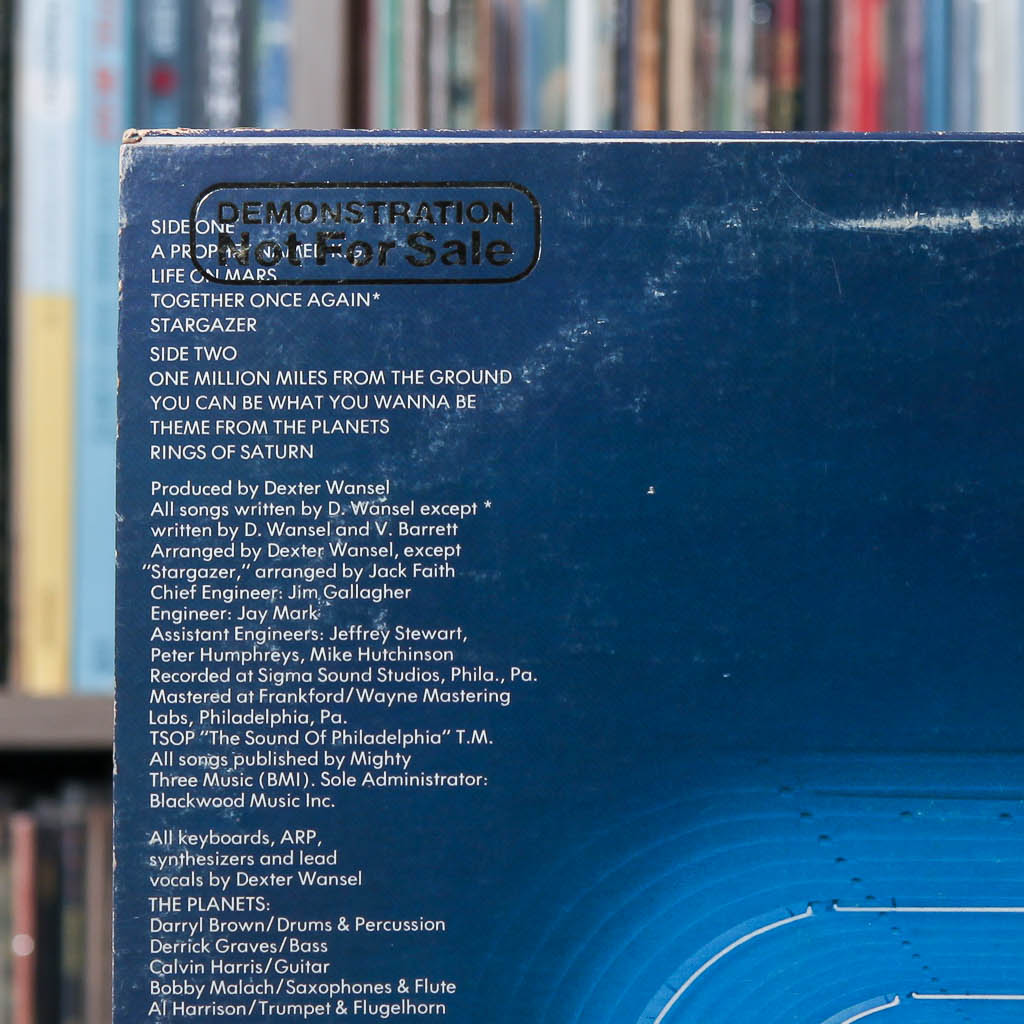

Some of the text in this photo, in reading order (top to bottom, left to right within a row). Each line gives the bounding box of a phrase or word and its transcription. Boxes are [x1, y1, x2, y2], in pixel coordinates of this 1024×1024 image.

[218, 201, 514, 225] DEMONSTRATION
[151, 219, 235, 235] SIDE ONE
[218, 230, 514, 267] Not For Sale
[151, 268, 185, 284] LIFE
[225, 268, 277, 282] MARS
[150, 292, 244, 308] TOGETHER
[249, 291, 302, 308] ONCE
[149, 316, 256, 333] STARGAZER
[150, 346, 237, 361] SIDE TWO
[149, 369, 512, 386] ONE MILLION MILES FROM THE GROUND
[150, 394, 476, 411] YOU CAN BE WHAT YOU WANNA BE
[150, 419, 389, 435] THEME FROM THE PLANETS
[150, 443, 313, 460] RINGS OF SATURN
[151, 478, 389, 500] Produced by Dexter Wansel
[150, 519, 458, 541] written by D. Wansel and V. Barrett
[141, 561, 455, 582] "Stargazer," arranged by Jack Faith
[150, 665, 537, 686] Recorded at Sigma Sound Studios, Phila., Pa.
[149, 686, 510, 707] Mastered at Frankford/Wayne Mastering
[148, 707, 347, 728] Labs, Philadelphia, Pa.
[149, 791, 335, 808] Blackwood Music Inc.
[149, 869, 362, 891] vocals by Dexter Wansel
[149, 896, 270, 912] THE PLANETS:
[149, 915, 445, 936] Darryl Brown/Drums & Percussion
[150, 935, 328, 954] Derrick Graves/Bass
[148, 956, 330, 977] Calvin Harris/Guitar
